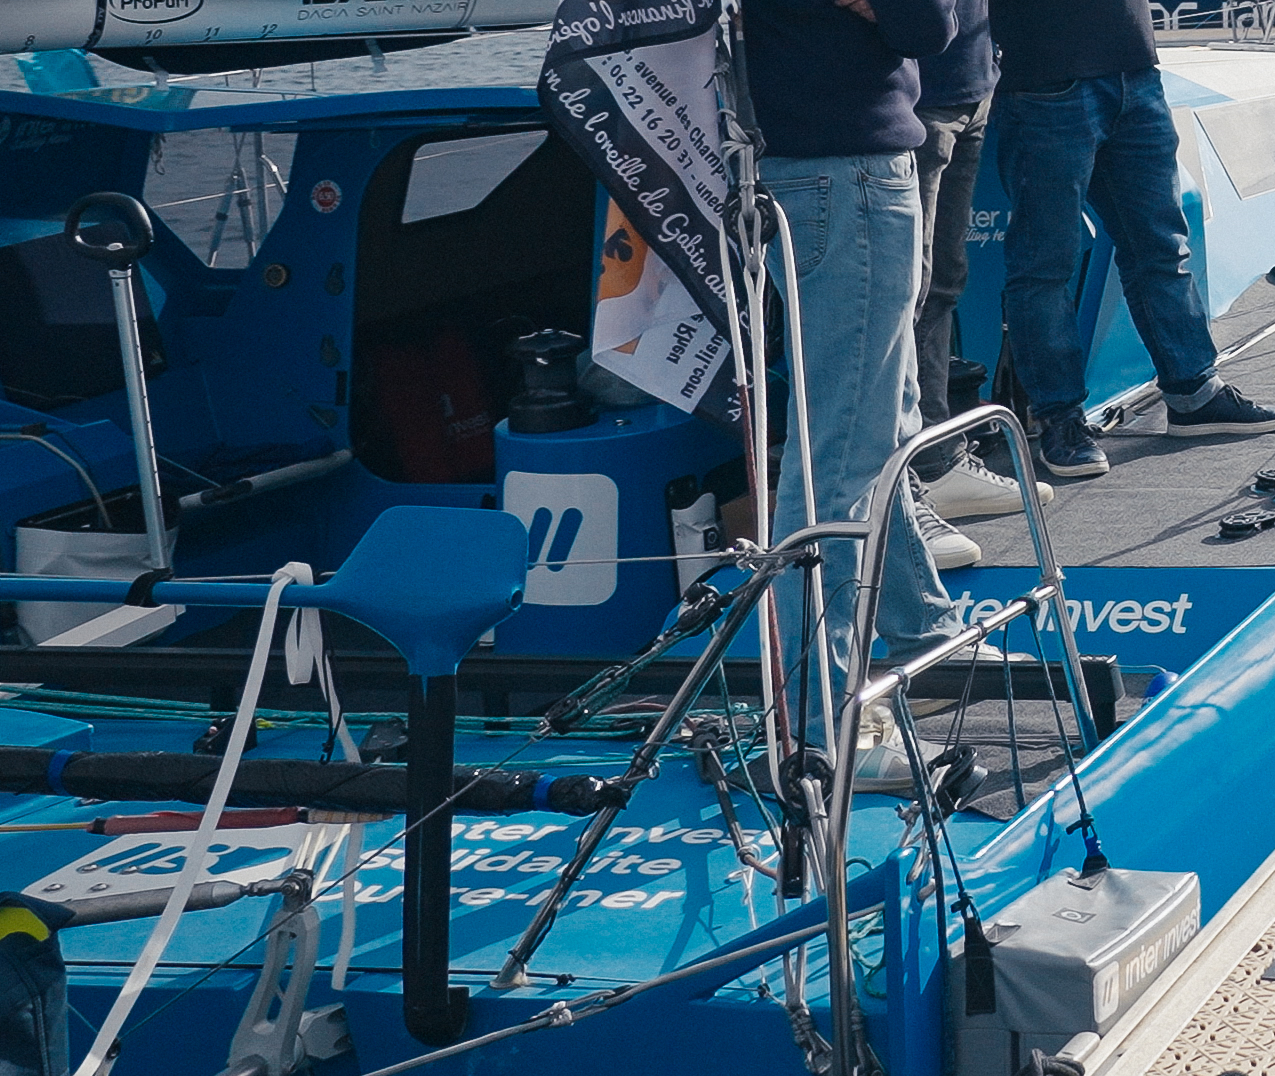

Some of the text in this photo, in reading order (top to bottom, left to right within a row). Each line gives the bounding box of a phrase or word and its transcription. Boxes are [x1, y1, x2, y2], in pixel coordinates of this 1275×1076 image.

[297, 9, 349, 21] DACIA
[356, 5, 404, 17] SAINT
[609, 64, 625, 88] 06
[622, 86, 645, 110] 22
[639, 108, 664, 132] 16
[657, 128, 682, 152] 20
[676, 148, 694, 170] 37
[633, 60, 678, 108] avenue
[674, 100, 693, 130] des
[558, 88, 591, 119] de
[594, 130, 647, 191] oreille
[637, 187, 670, 218] de
[657, 213, 705, 275] Gabin
[1125, 937, 1162, 992] inter
